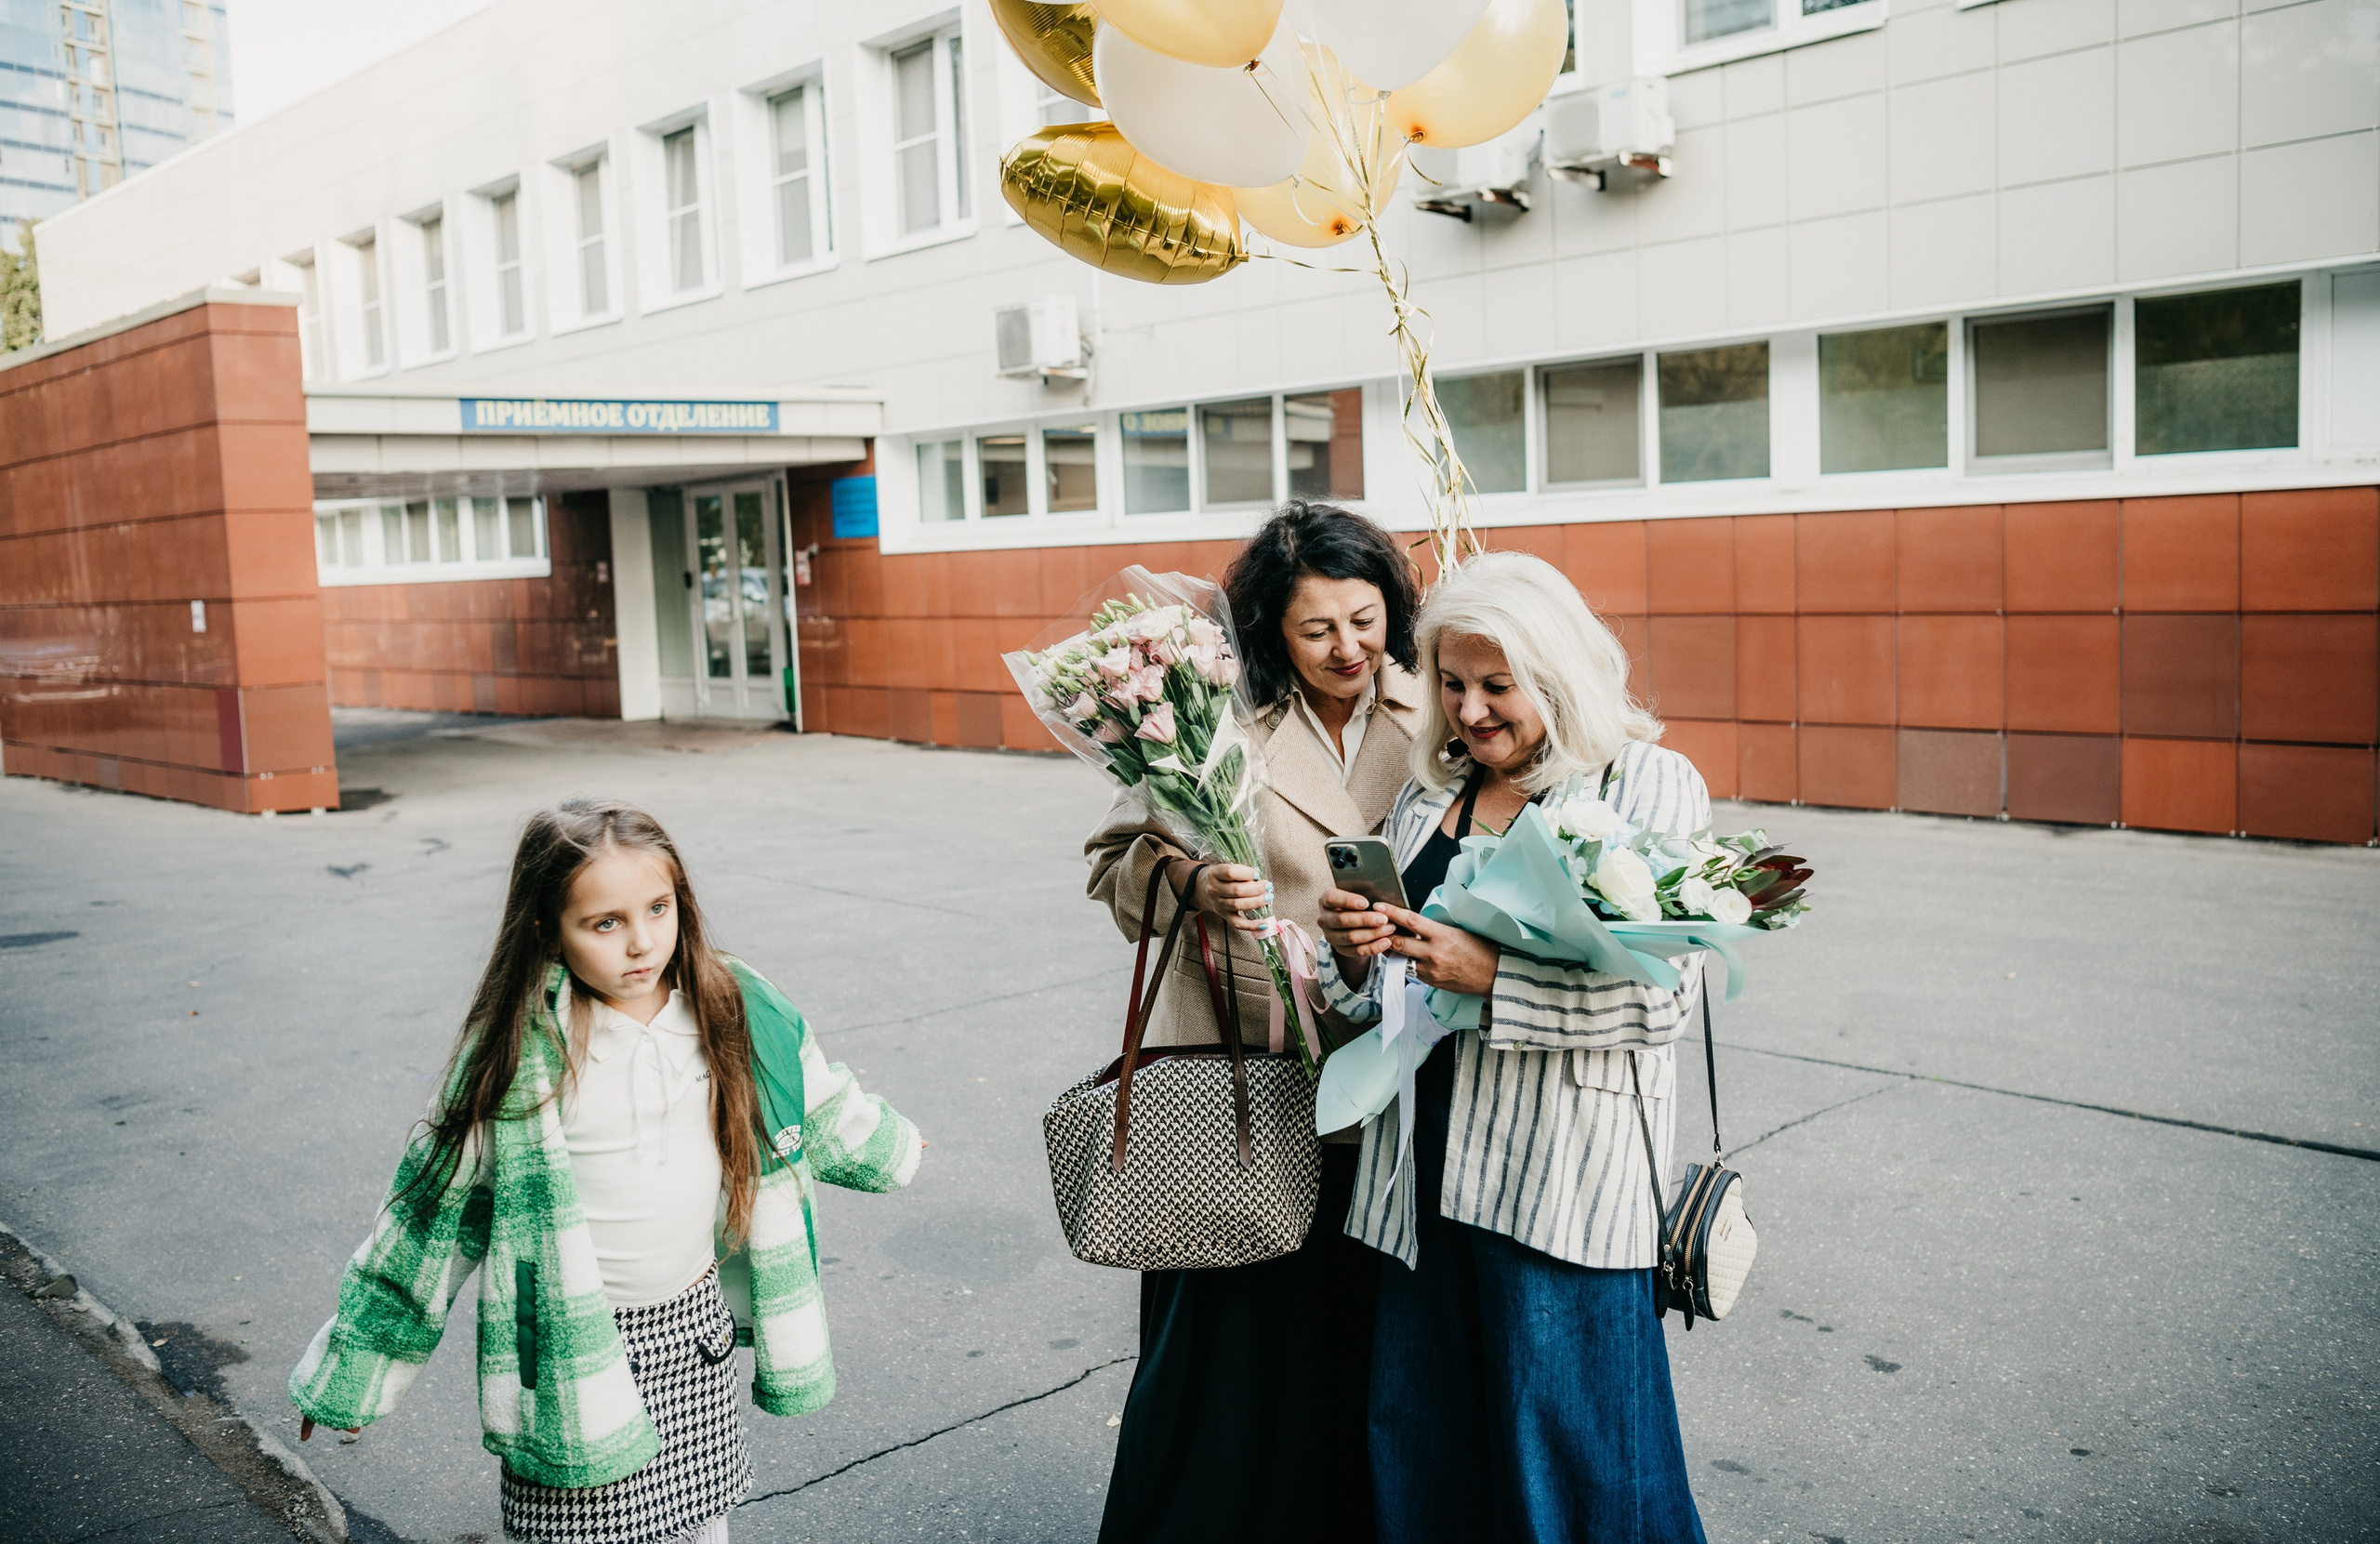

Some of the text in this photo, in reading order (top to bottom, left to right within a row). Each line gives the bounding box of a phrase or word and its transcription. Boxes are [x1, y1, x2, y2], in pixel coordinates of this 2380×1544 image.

[475, 399, 770, 432] ПРИЁМНОЕ ОТДЕЛЕНИЕ
[695, 1069, 711, 1084] MAG
